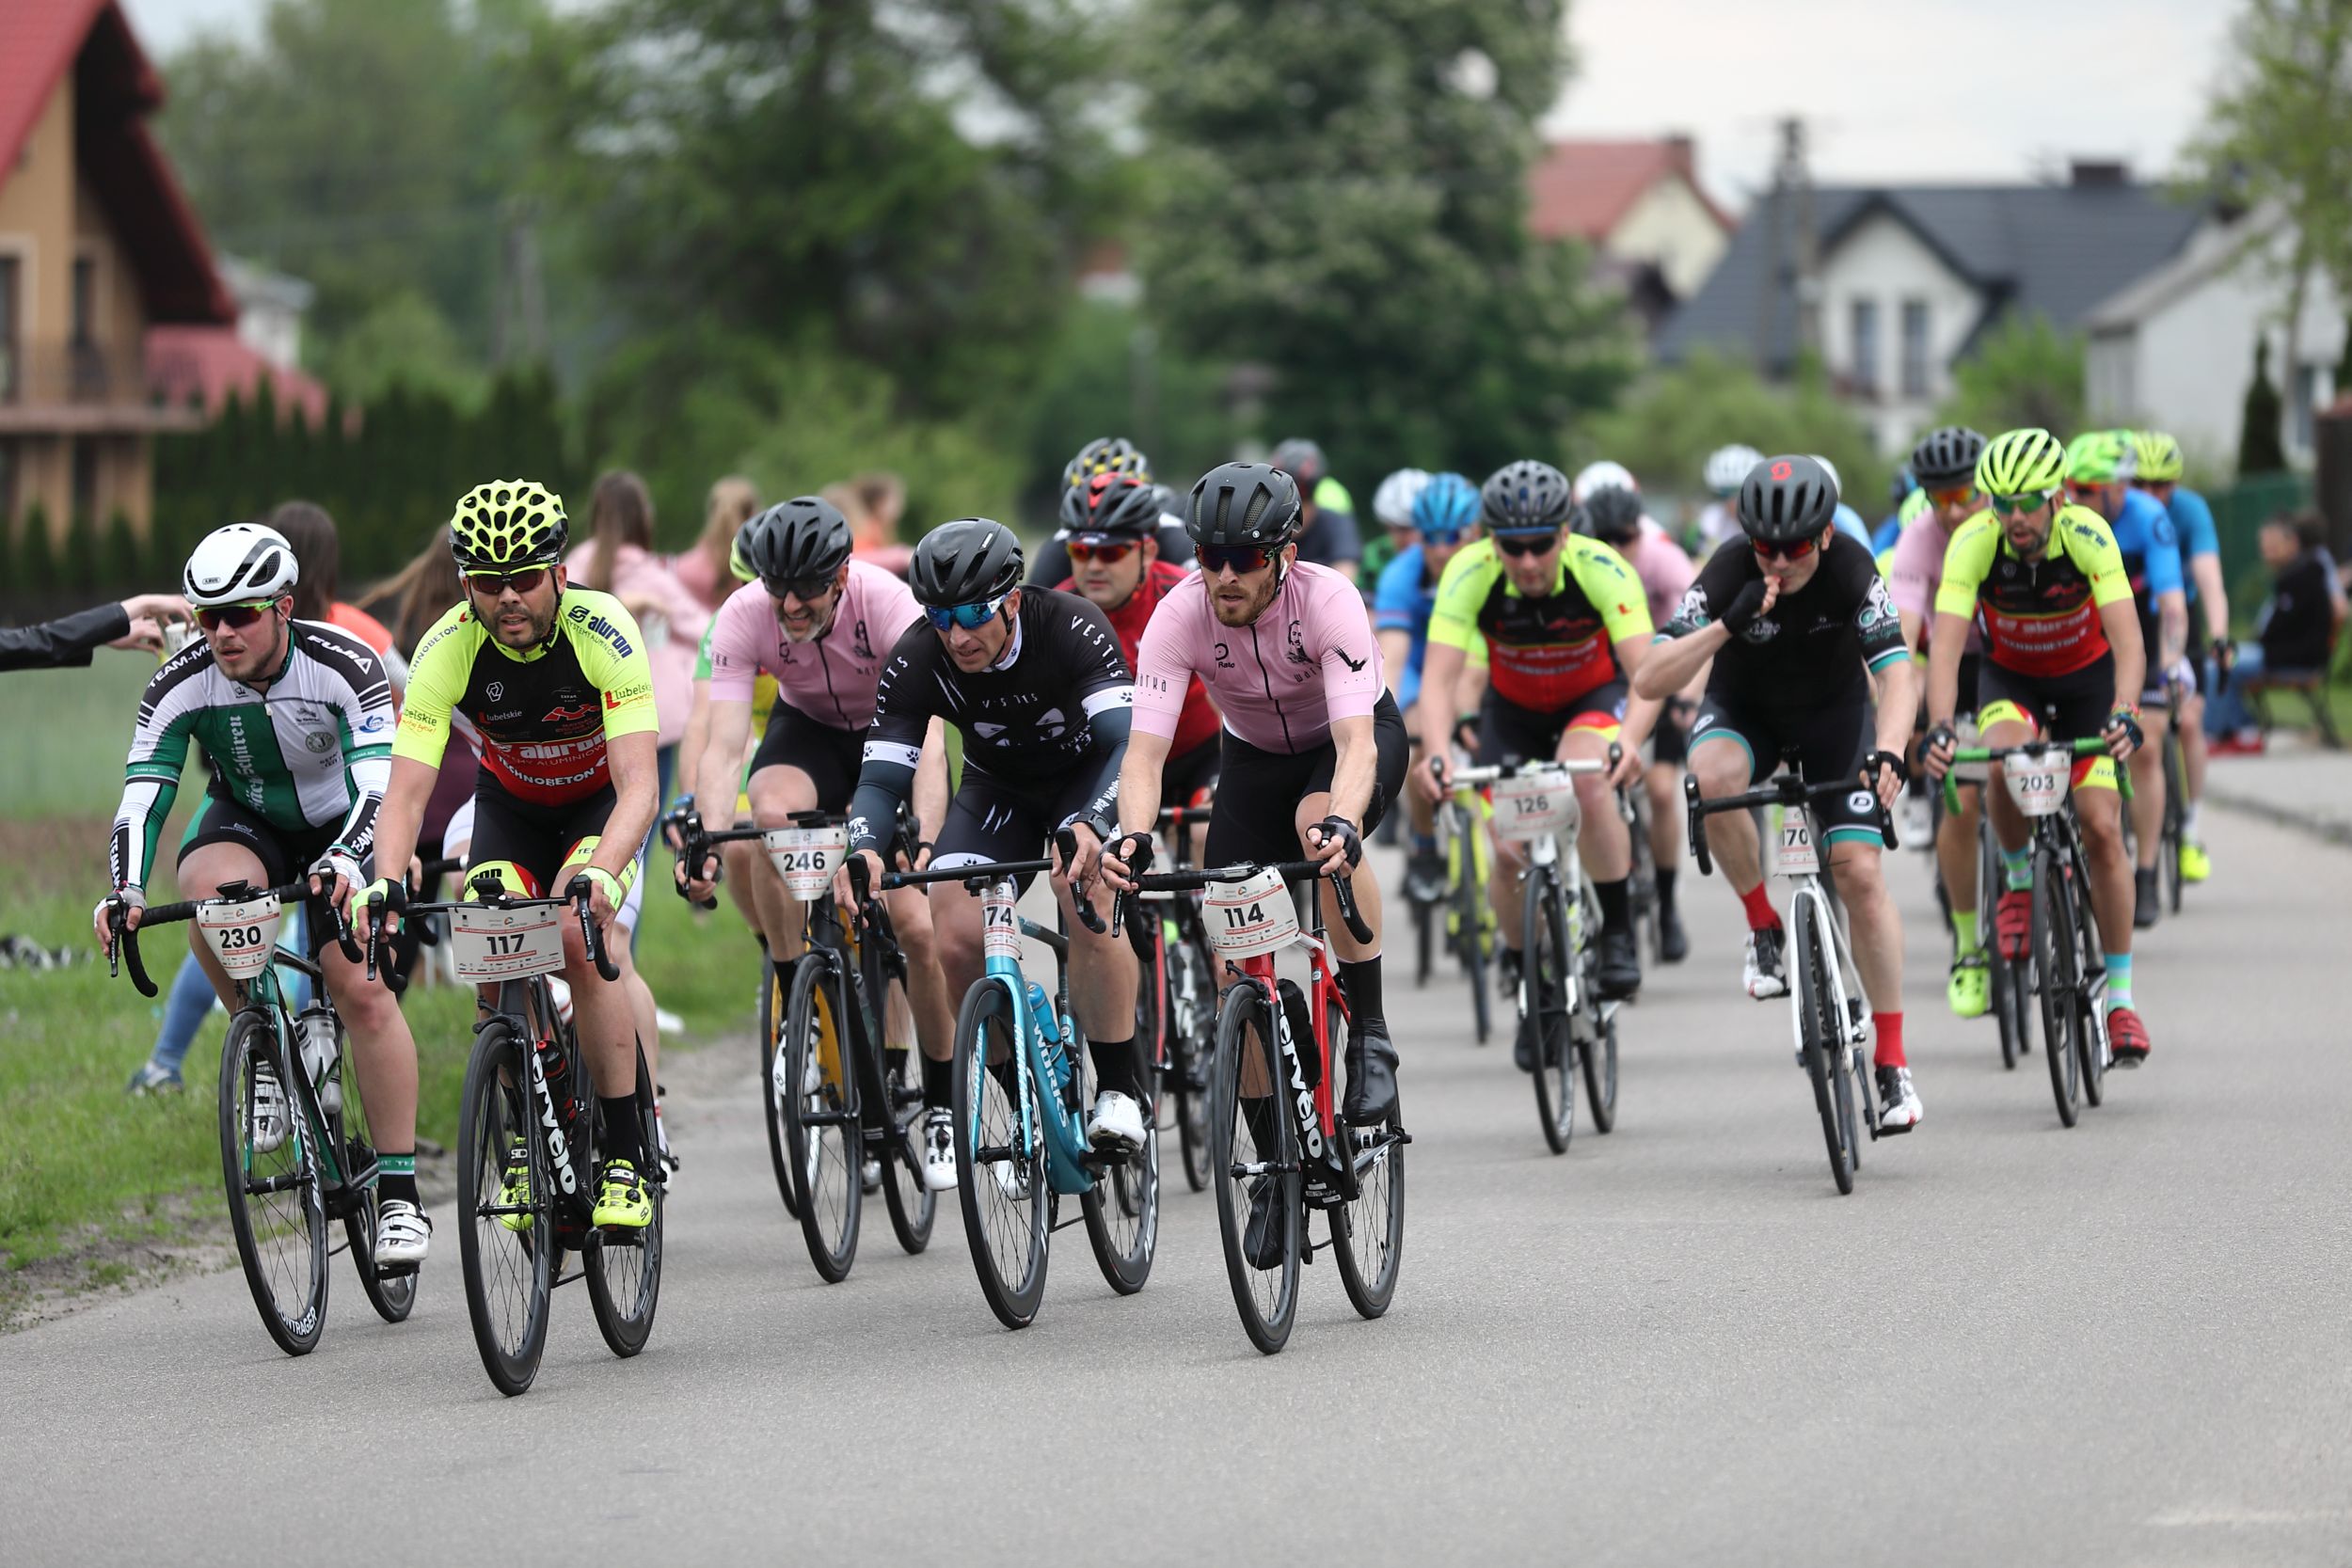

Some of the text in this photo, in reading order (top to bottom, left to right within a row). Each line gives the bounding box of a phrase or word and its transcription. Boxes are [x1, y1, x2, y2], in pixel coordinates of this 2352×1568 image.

[587, 615, 633, 658] aluron
[1071, 614, 1124, 678] VESTIS
[870, 656, 910, 728] VESTIS
[981, 692, 1039, 709] VSTIS
[485, 709, 523, 721] lubelskie
[519, 731, 606, 759] aluron
[497, 754, 596, 787] TECHNOBETON
[2020, 774, 2055, 793] 203
[1515, 795, 1549, 815] 126
[1782, 828, 1808, 846] 70
[783, 850, 826, 873] 246
[982, 906, 1013, 927] 74
[1224, 902, 1264, 928] 114
[219, 926, 262, 949] 230
[486, 933, 525, 956] 117
